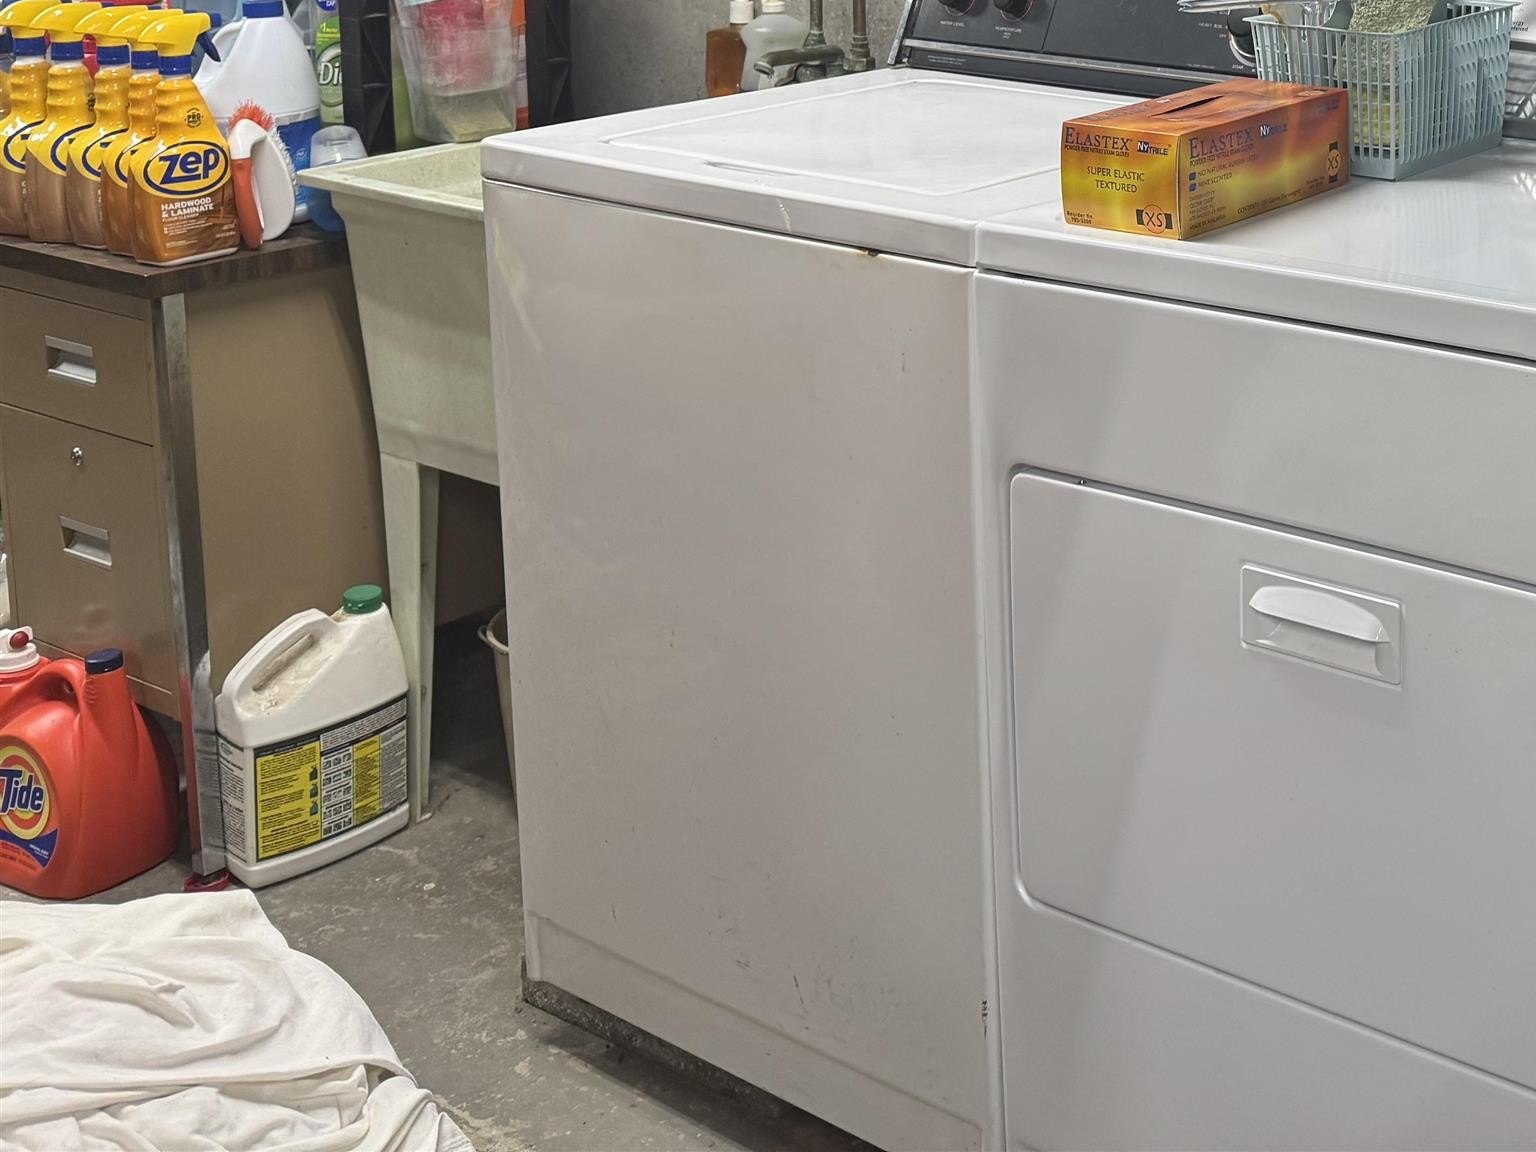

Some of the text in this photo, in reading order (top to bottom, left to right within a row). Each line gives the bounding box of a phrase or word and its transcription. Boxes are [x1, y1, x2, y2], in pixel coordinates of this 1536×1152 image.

[1064, 127, 1130, 151] ELASTEX
[1327, 152, 1340, 170] XS
[1087, 165, 1145, 181] SUPER ELASTIC
[1095, 179, 1138, 193] TEXTURED
[161, 197, 212, 211] HARDWOOD
[170, 203, 215, 217] LAMINATE
[1145, 212, 1163, 227] XS
[0, 767, 45, 815] Tide
